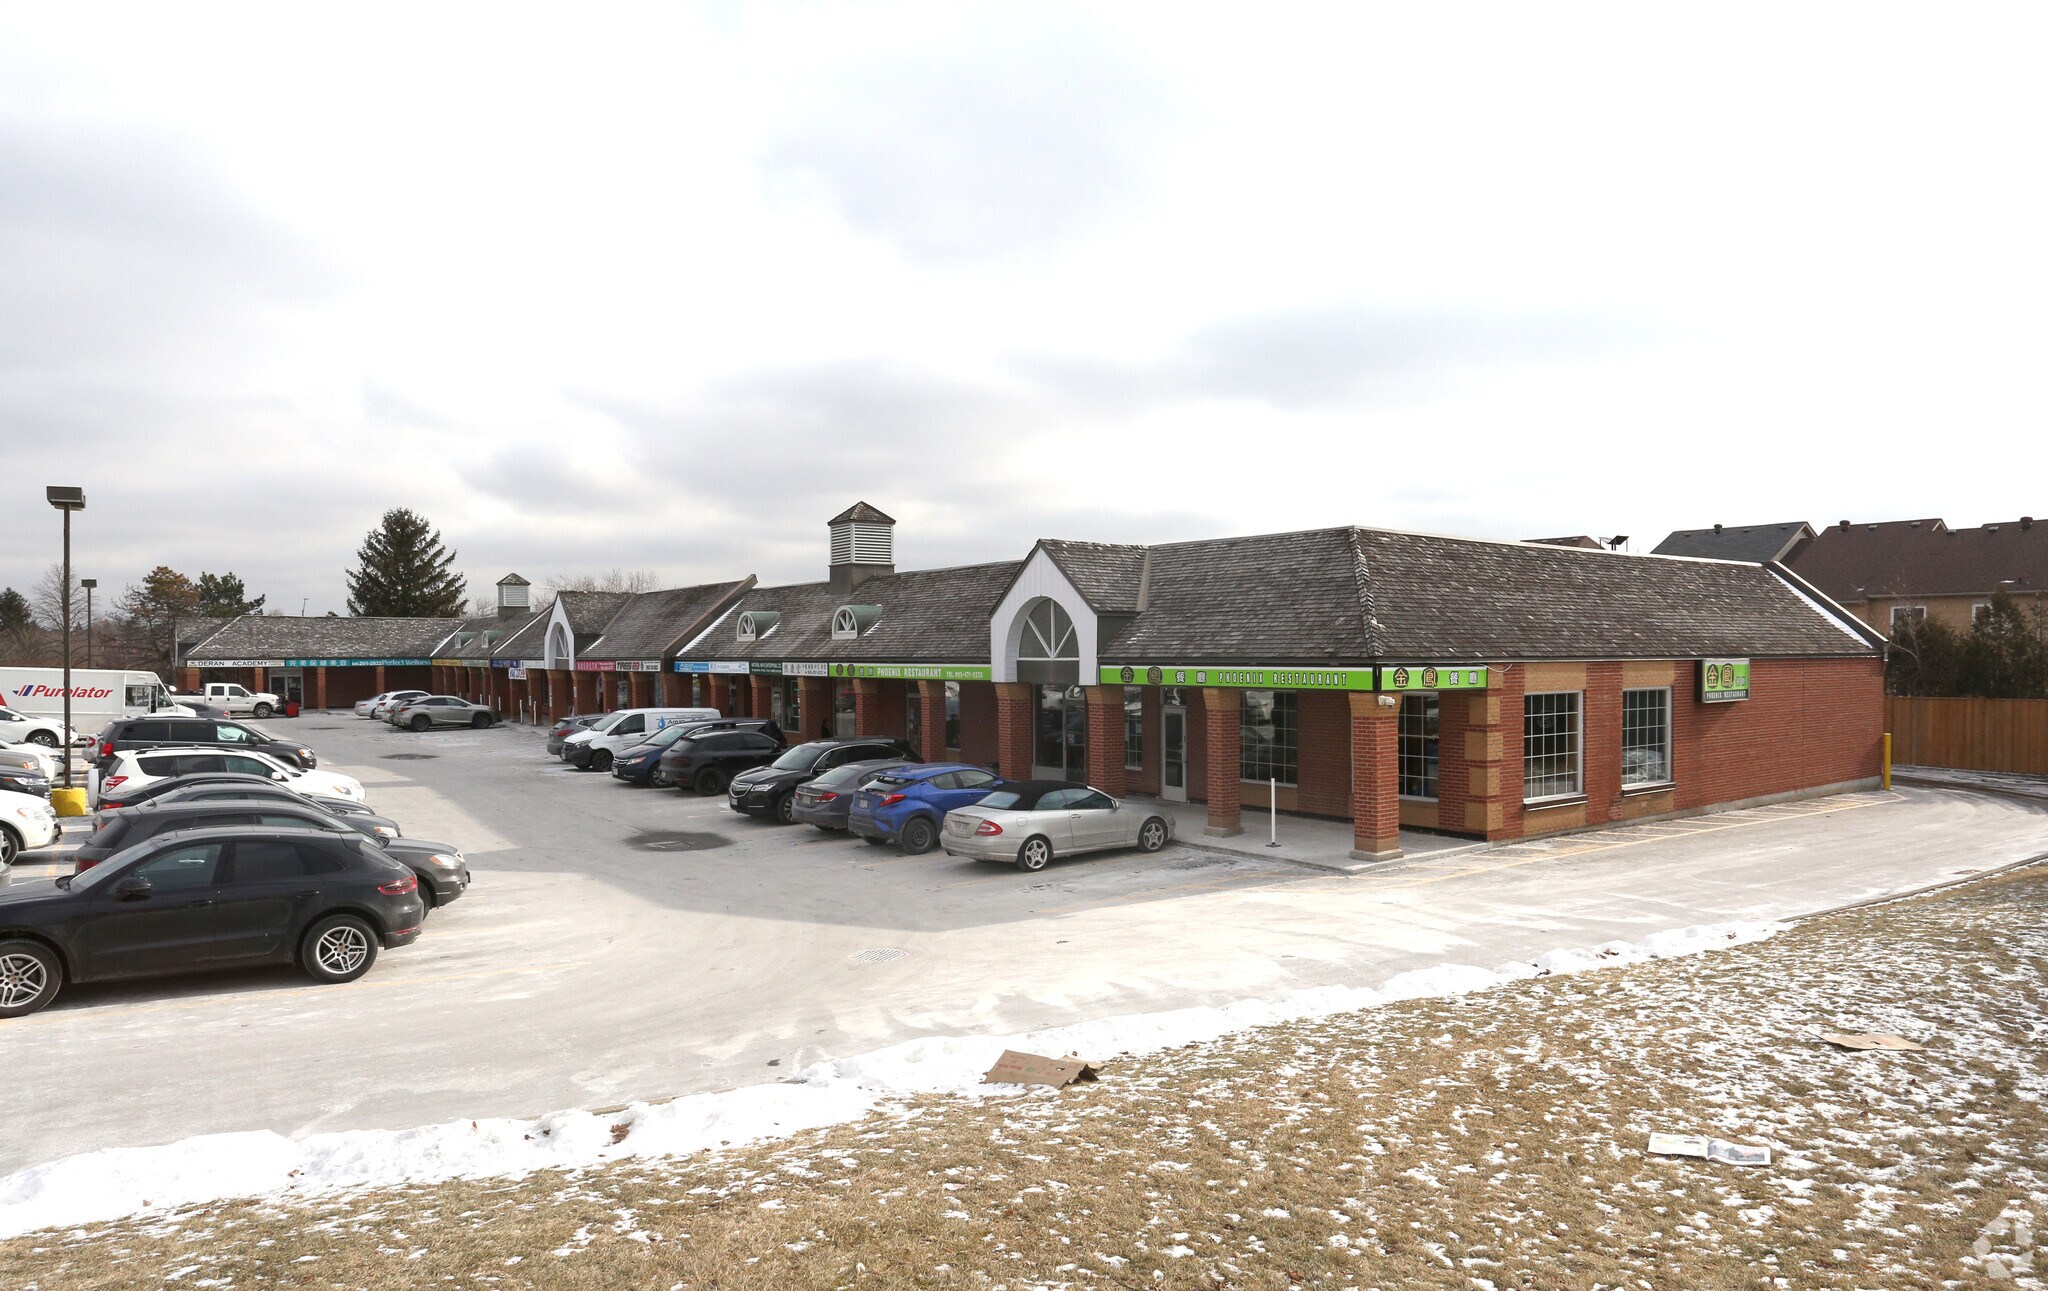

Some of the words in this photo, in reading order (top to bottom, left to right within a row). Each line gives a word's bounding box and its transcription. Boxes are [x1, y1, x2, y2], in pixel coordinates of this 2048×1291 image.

[405, 659, 432, 667] Wellness
[877, 667, 901, 676] PHOENIX
[904, 668, 942, 678] RESTAURANT
[1218, 672, 1263, 684] PHOENIX
[1273, 673, 1347, 686] RESTAURANT
